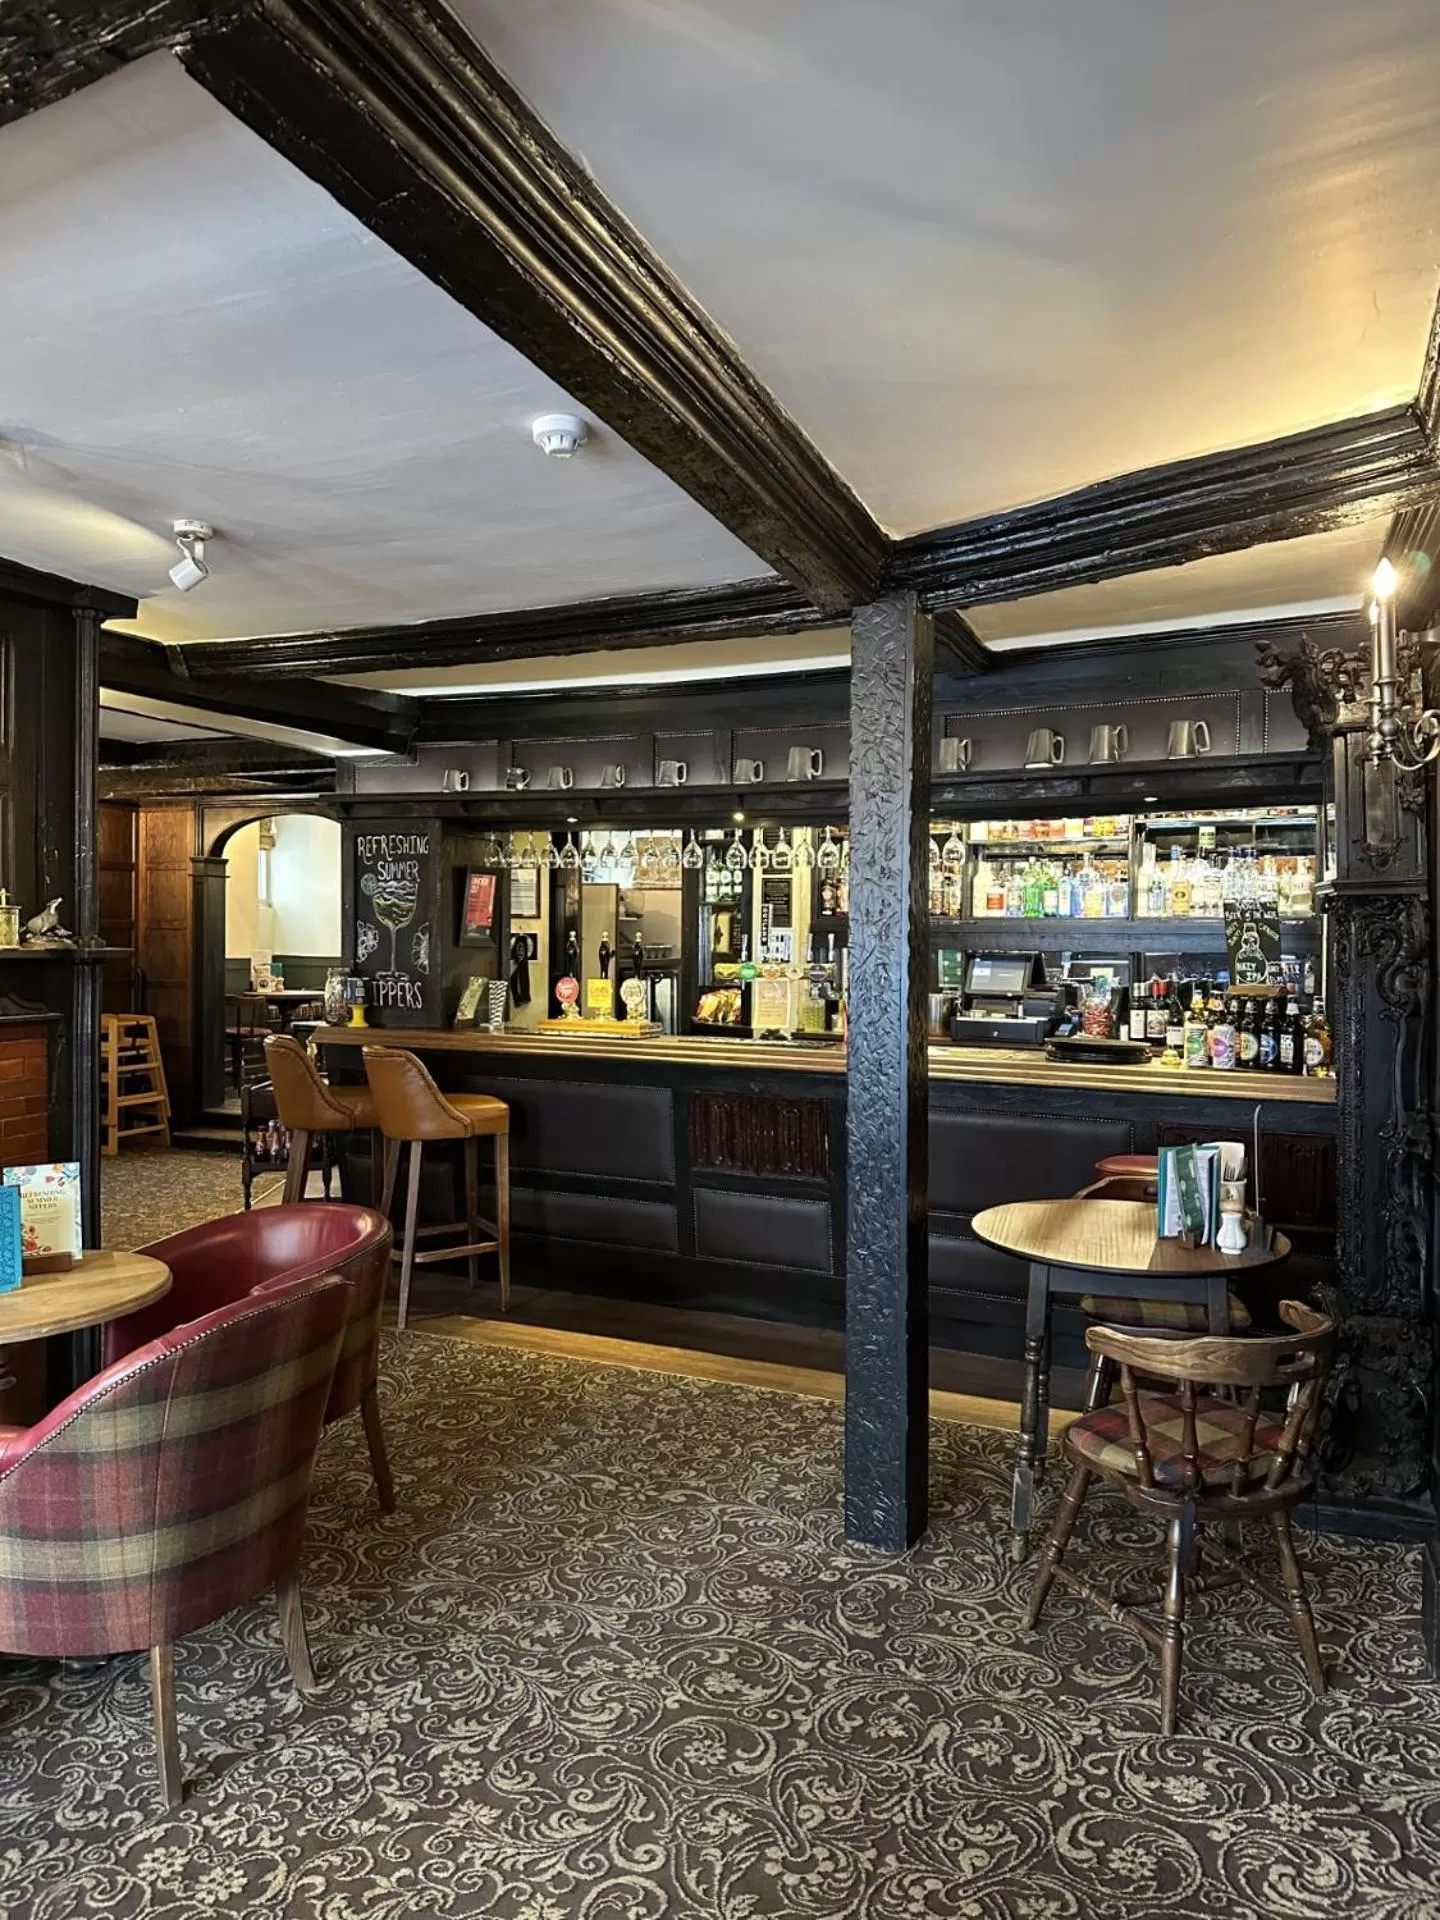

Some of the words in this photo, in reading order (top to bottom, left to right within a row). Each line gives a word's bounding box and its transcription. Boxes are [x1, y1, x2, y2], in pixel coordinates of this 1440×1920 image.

[357, 834, 430, 865] REFRESHING
[377, 860, 421, 882] SUMMER
[371, 980, 423, 1009] IPPERS
